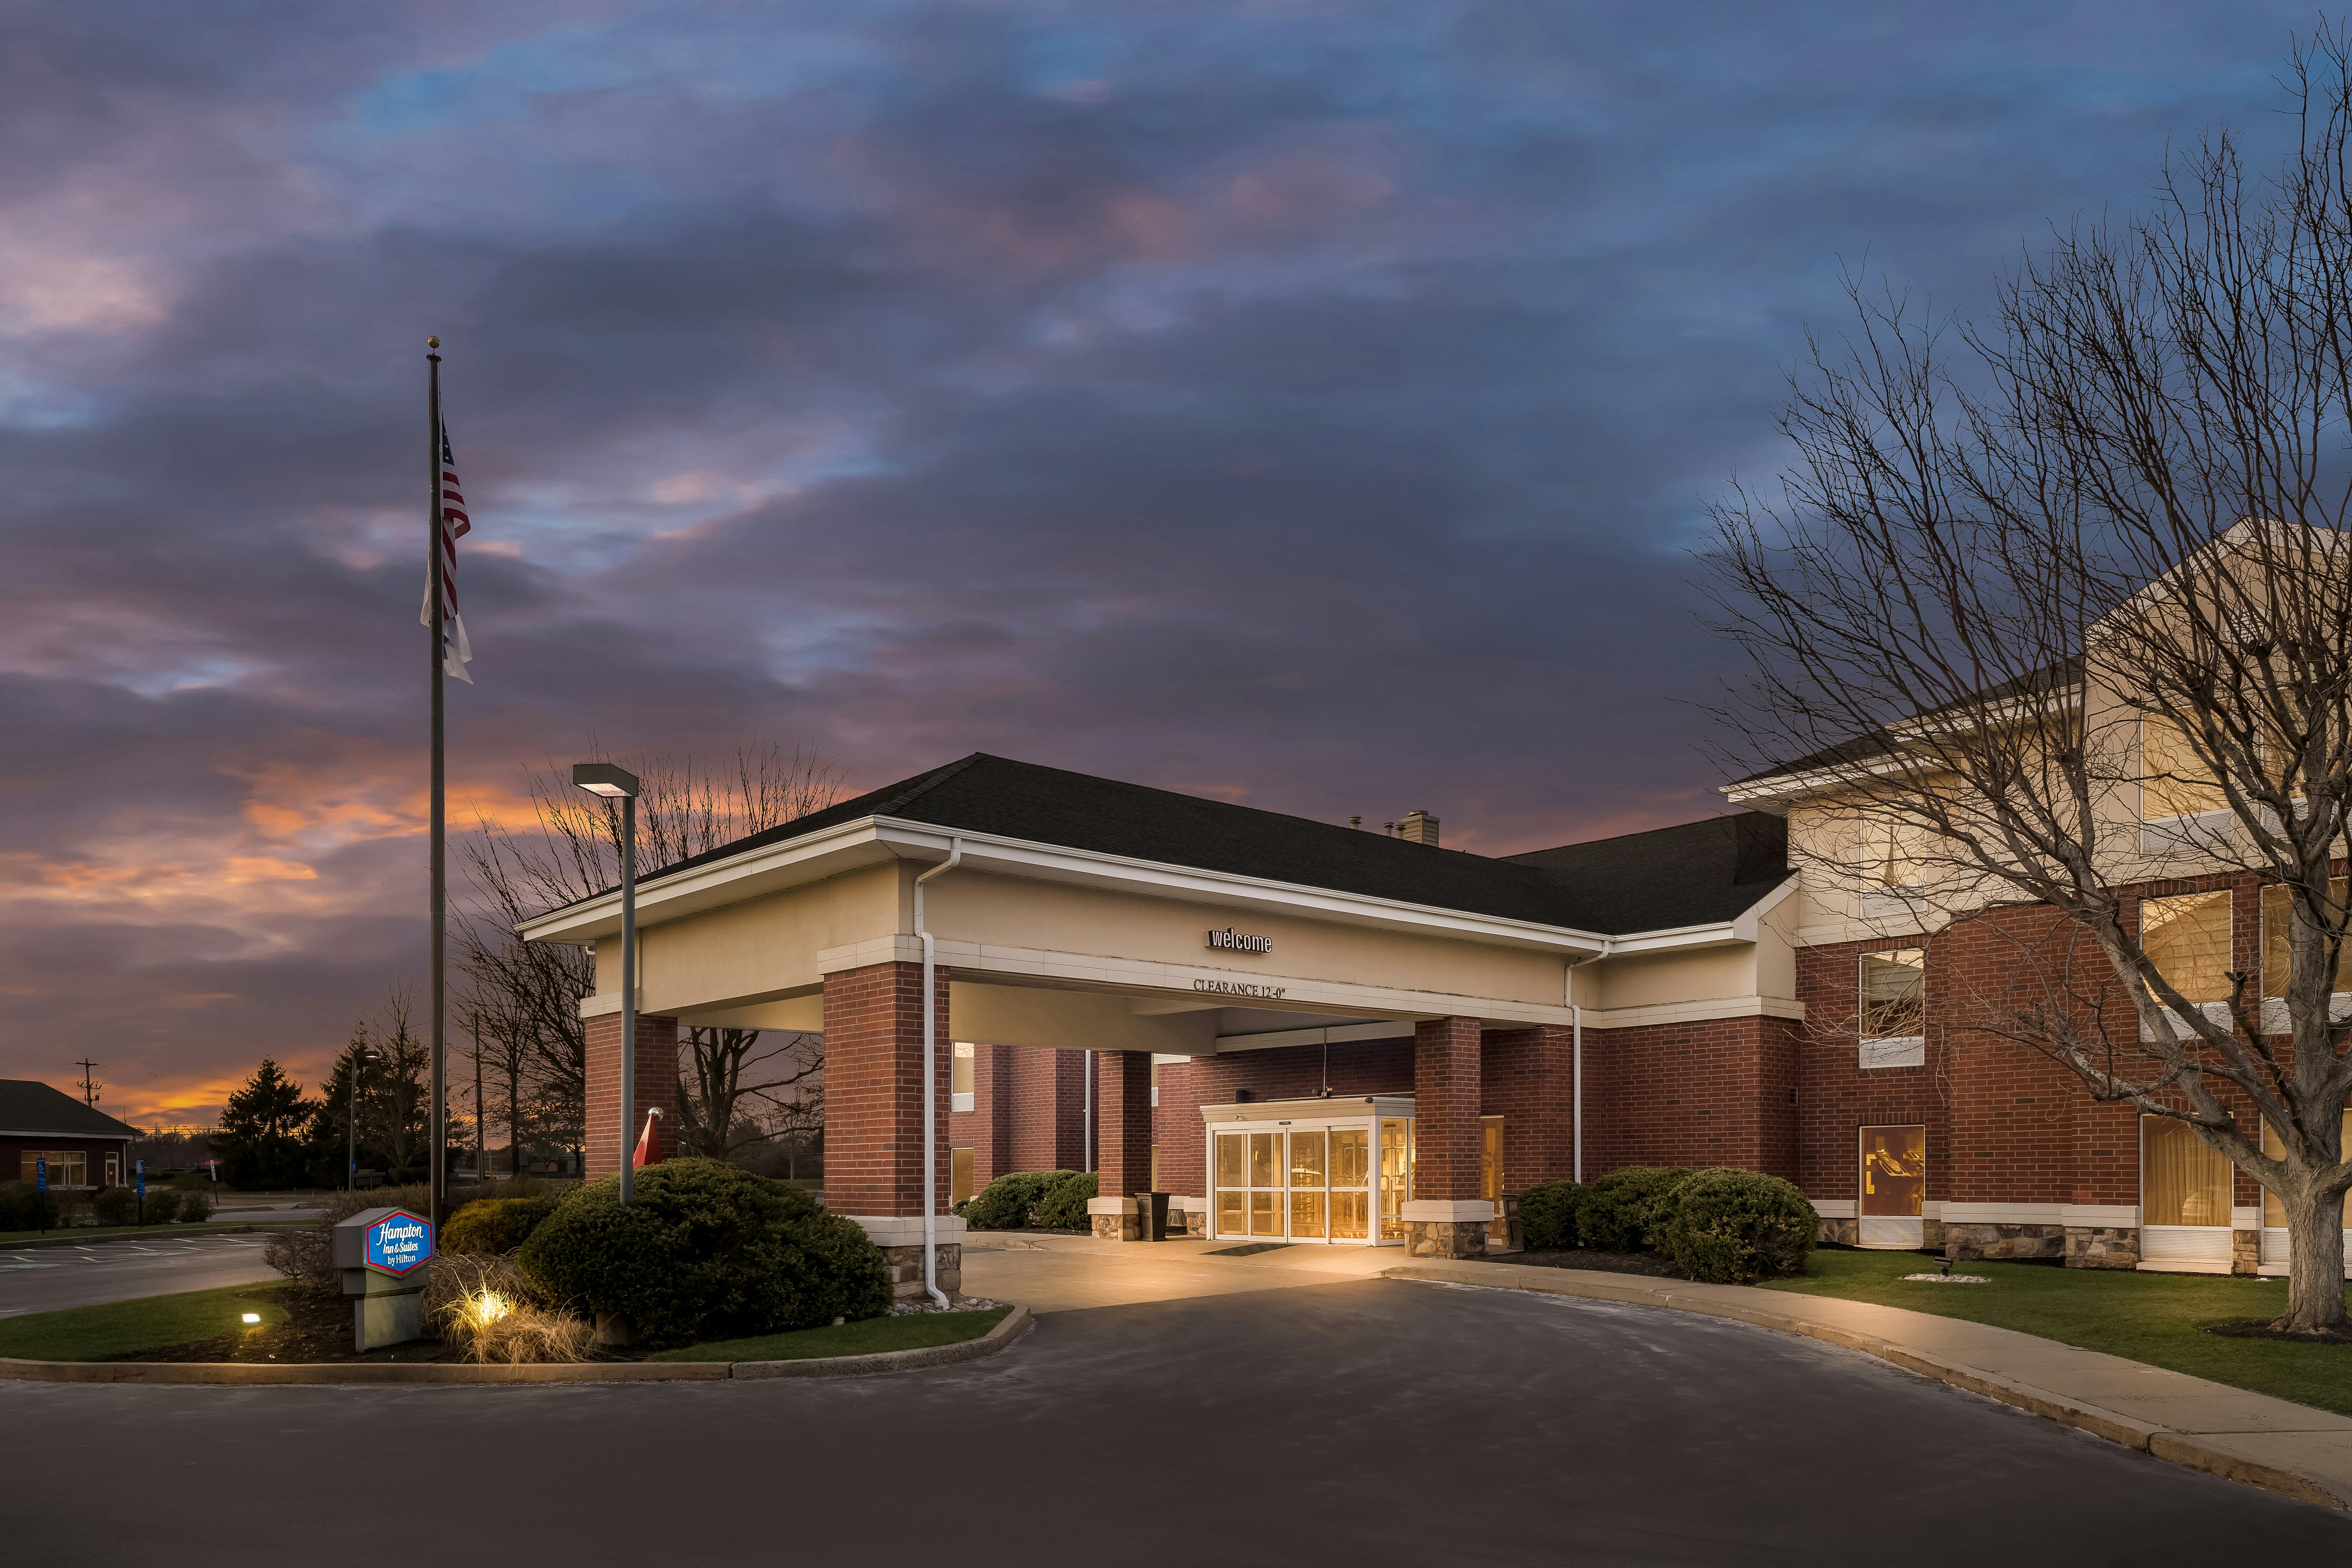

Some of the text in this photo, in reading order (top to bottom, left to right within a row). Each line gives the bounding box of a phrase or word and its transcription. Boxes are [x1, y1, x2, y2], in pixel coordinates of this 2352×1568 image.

[1209, 927, 1272, 953] welcome
[1194, 979, 1258, 996] CLEARANCE
[376, 1222, 423, 1245] Hampton
[388, 1254, 416, 1267] by Hilton
